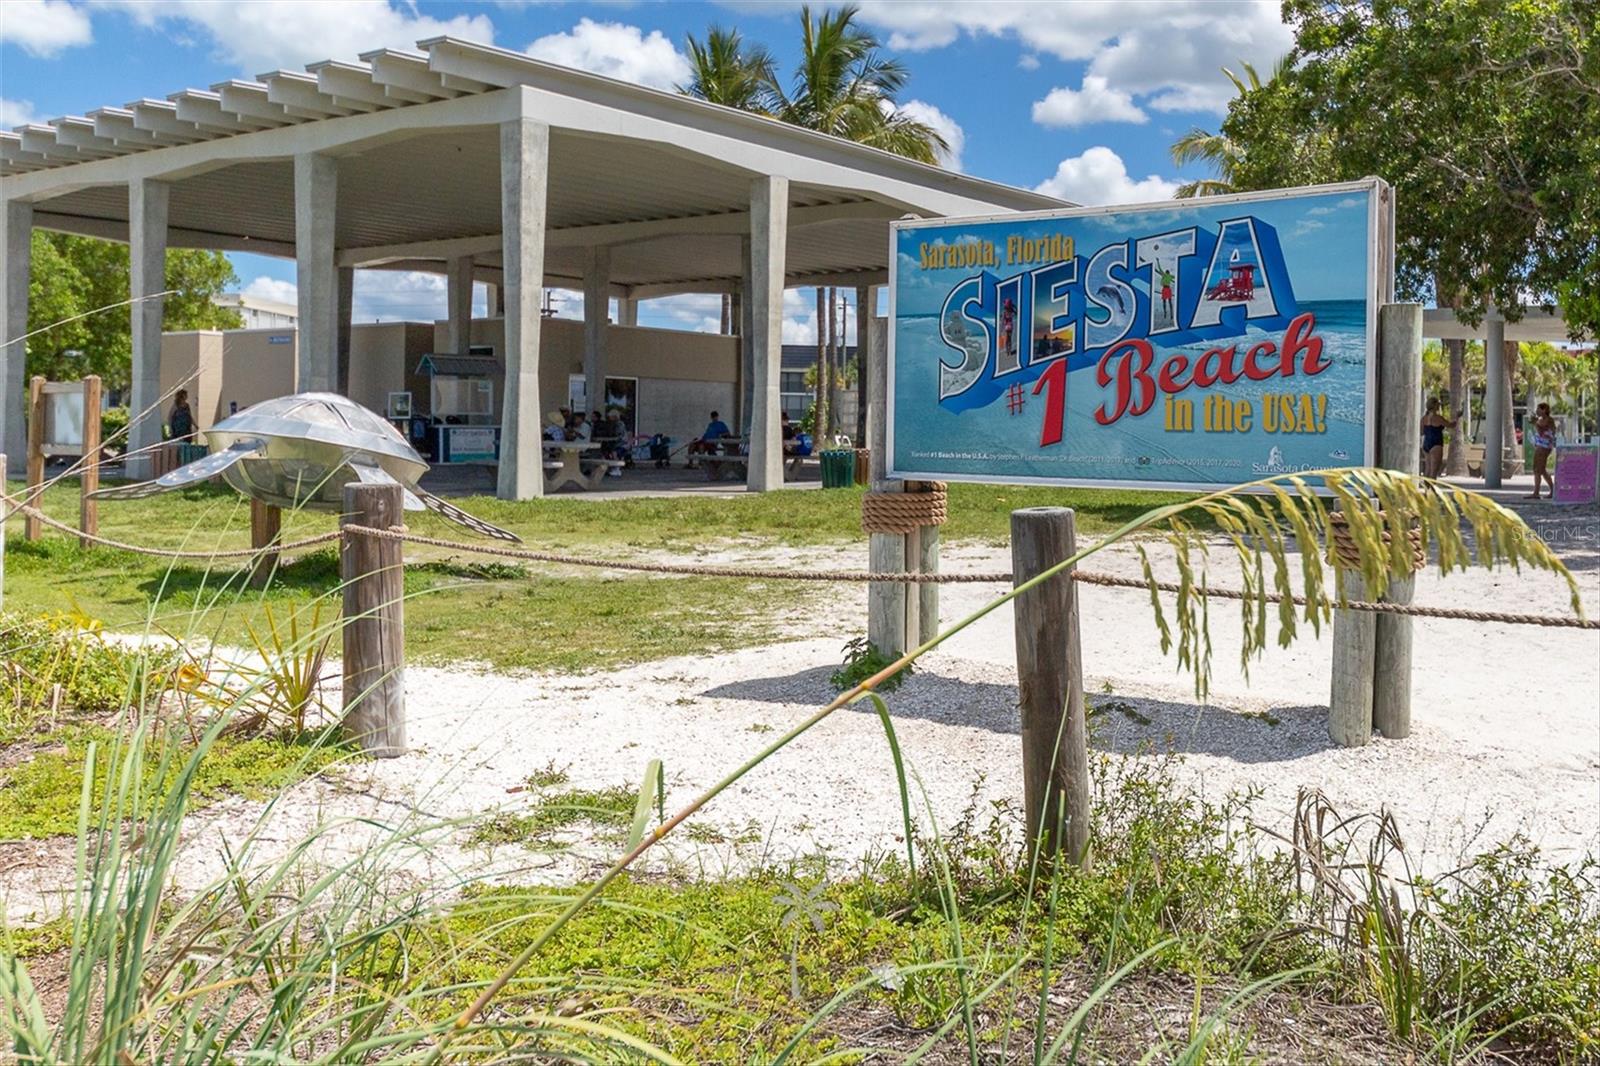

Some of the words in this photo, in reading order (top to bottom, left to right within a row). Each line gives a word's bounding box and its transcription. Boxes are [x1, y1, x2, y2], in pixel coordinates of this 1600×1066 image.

[920, 239, 1001, 270] Sarasota,
[1007, 233, 1075, 264] Florida
[939, 216, 1285, 404] SIESTA
[1007, 358, 1067, 448] #1
[1094, 312, 1333, 426] Beach
[1165, 394, 1194, 433] in
[1204, 394, 1253, 433] the
[1263, 393, 1327, 434] USA!
[938, 451, 955, 459] Beach
[1252, 462, 1298, 473] Sarasota
